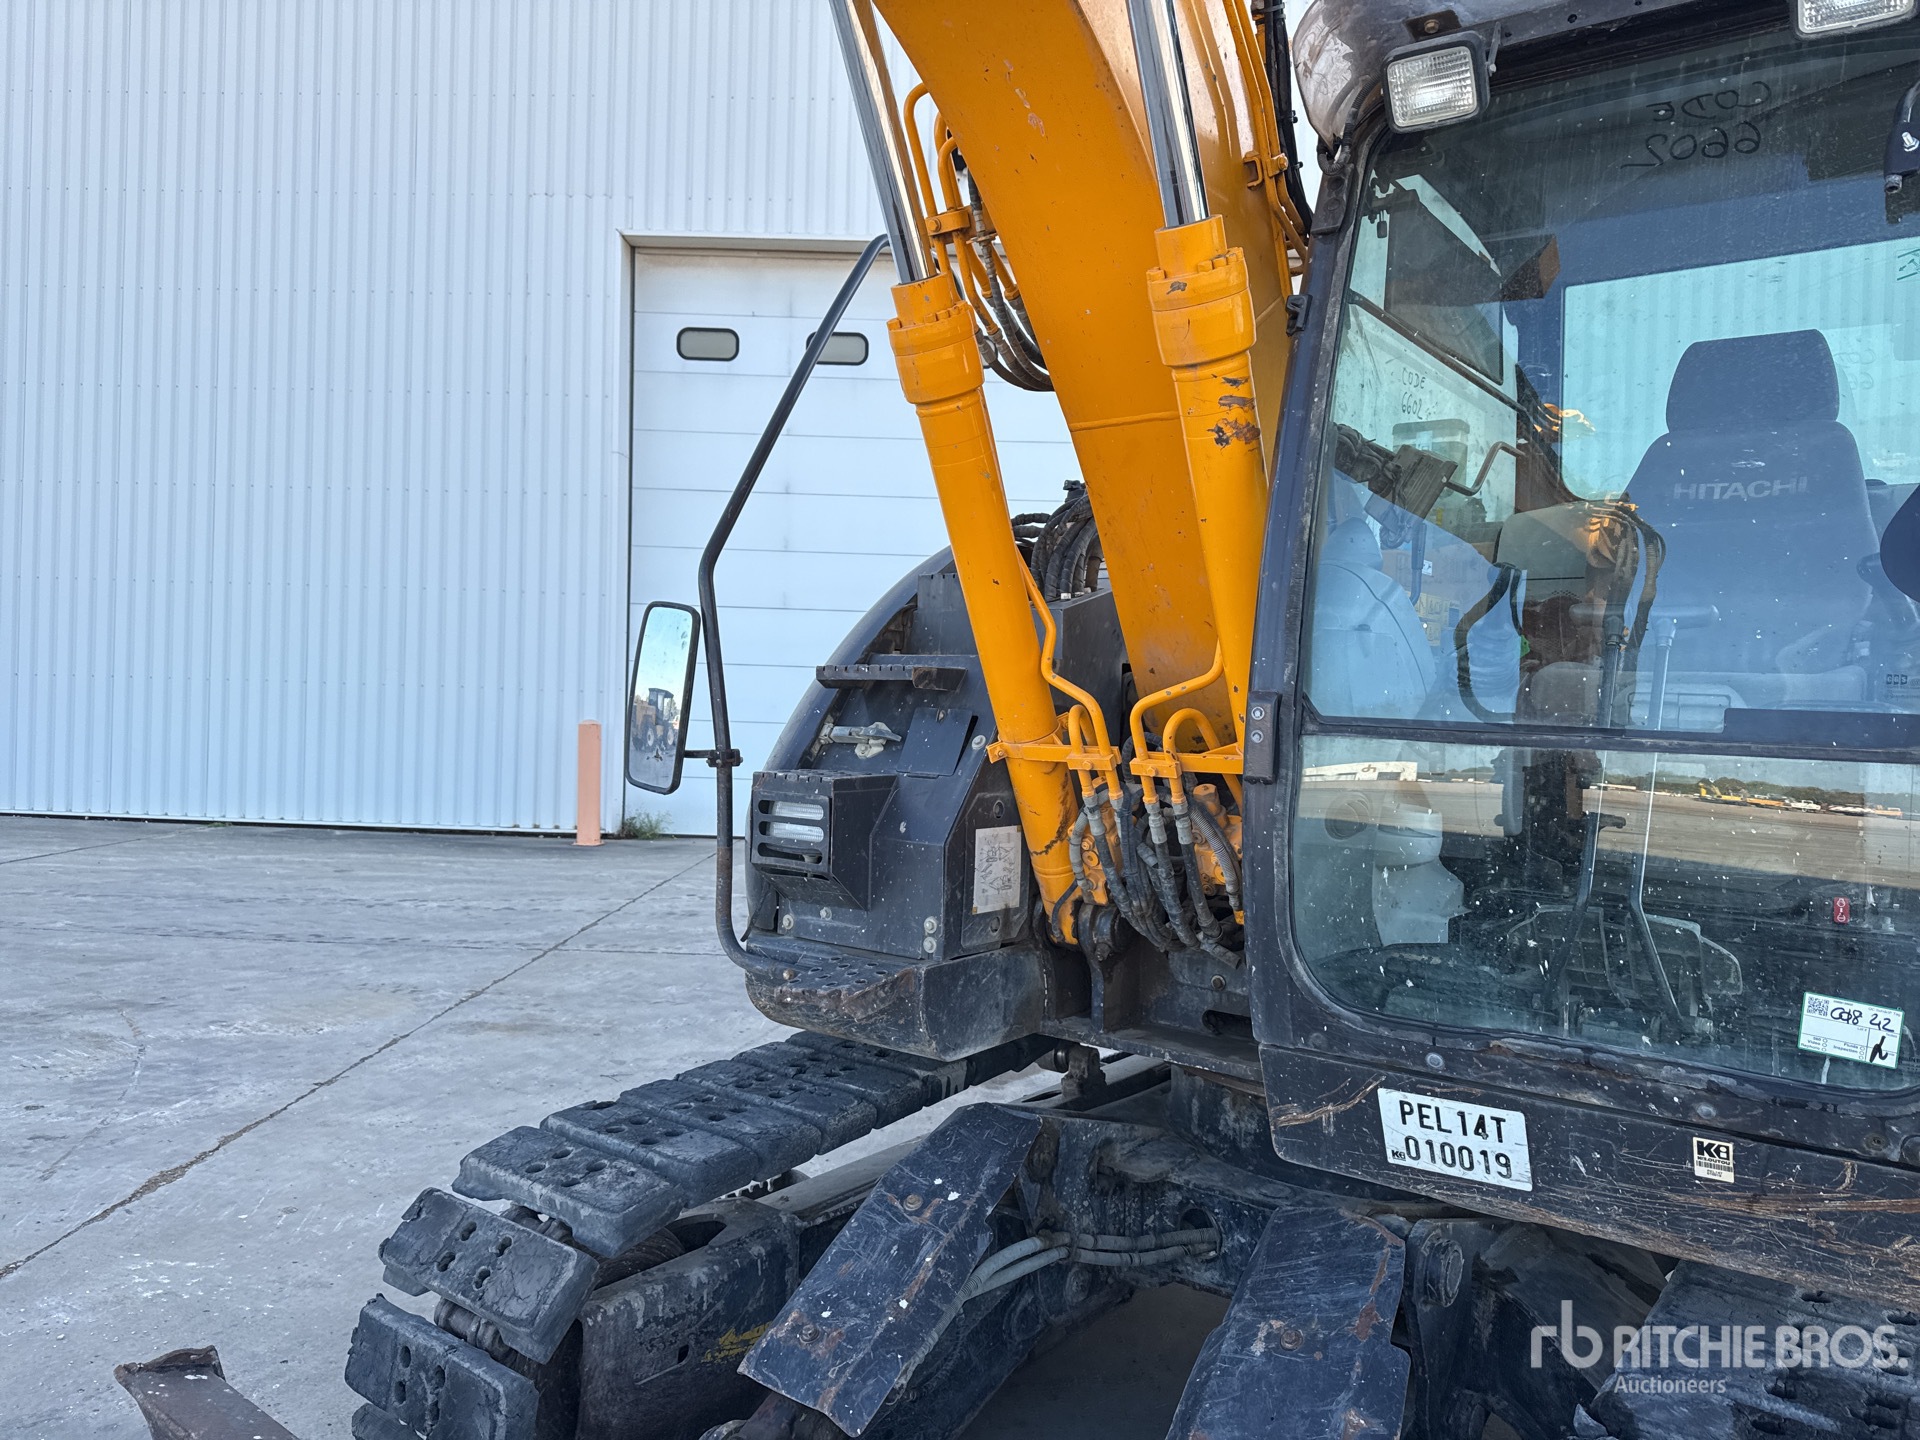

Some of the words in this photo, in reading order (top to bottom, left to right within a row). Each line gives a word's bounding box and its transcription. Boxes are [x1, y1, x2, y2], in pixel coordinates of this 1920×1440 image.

[1401, 366, 1426, 390] CODE
[1400, 391, 1424, 420] 6602
[1672, 476, 1808, 500] HITACHI
[1398, 1099, 1506, 1144] PEL14T
[1404, 1135, 1513, 1180] 010019
